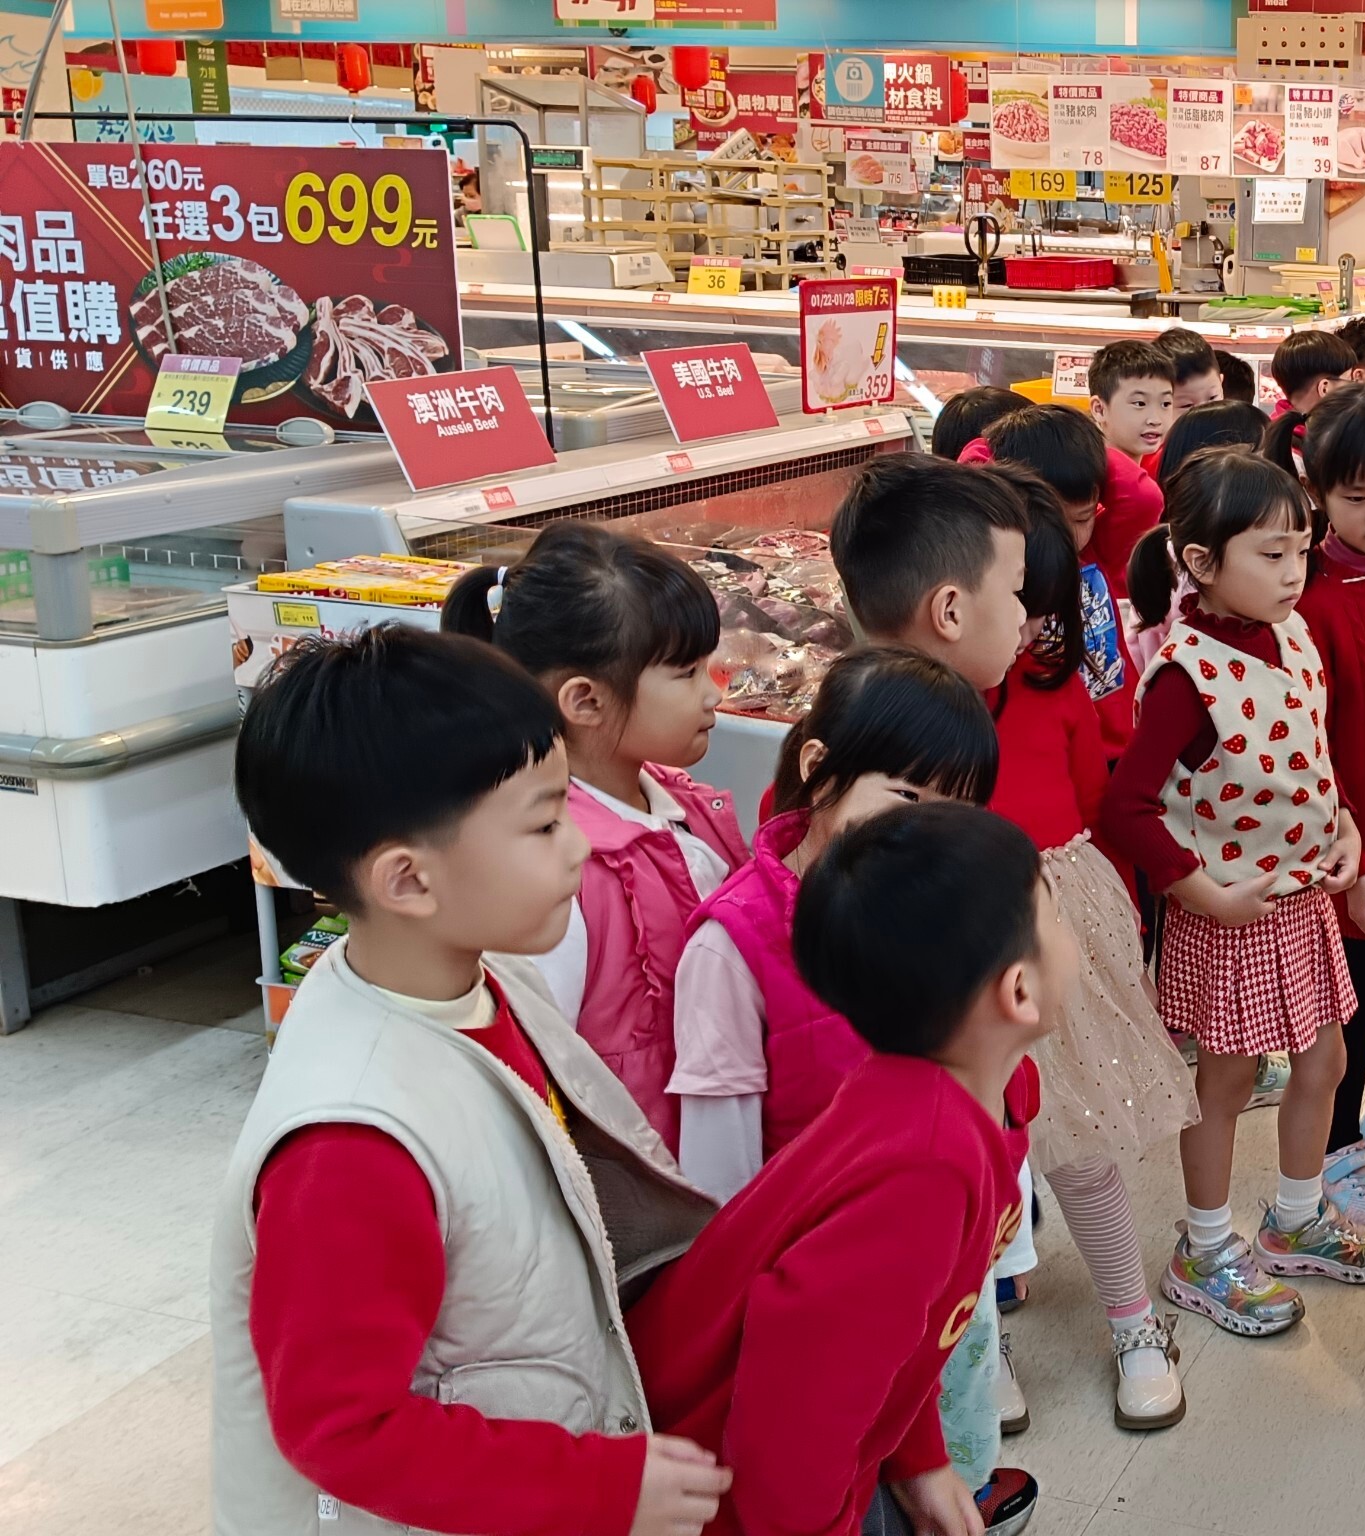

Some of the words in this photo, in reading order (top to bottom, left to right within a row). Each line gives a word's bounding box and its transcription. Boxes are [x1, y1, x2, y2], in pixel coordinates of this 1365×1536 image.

[737, 94, 794, 112] 鍋物專區
[884, 87, 942, 110] 材食料
[1058, 87, 1097, 98] 特價商品
[1178, 90, 1218, 103] 特價商品
[1292, 89, 1331, 102] 特價商品
[1082, 151, 1103, 166] 78
[1200, 155, 1221, 170] 87
[1314, 158, 1331, 173] 39
[87, 158, 205, 190] 單包260元
[1029, 172, 1065, 192] 169
[1126, 173, 1164, 196] 125
[139, 171, 439, 247] 任選3包699元
[0, 210, 87, 275] 肉品
[707, 274, 726, 289] 36
[0, 279, 122, 346] 值購
[180, 359, 221, 373] 特價商品
[672, 357, 742, 389] 美國牛肉
[697, 385, 715, 398] U.S.
[718, 384, 734, 397] Beef
[864, 373, 889, 399] 359
[168, 389, 211, 416] 239
[407, 384, 505, 424] 澳洲牛肉
[437, 420, 473, 438] Aussie
[475, 416, 499, 433] Beef
